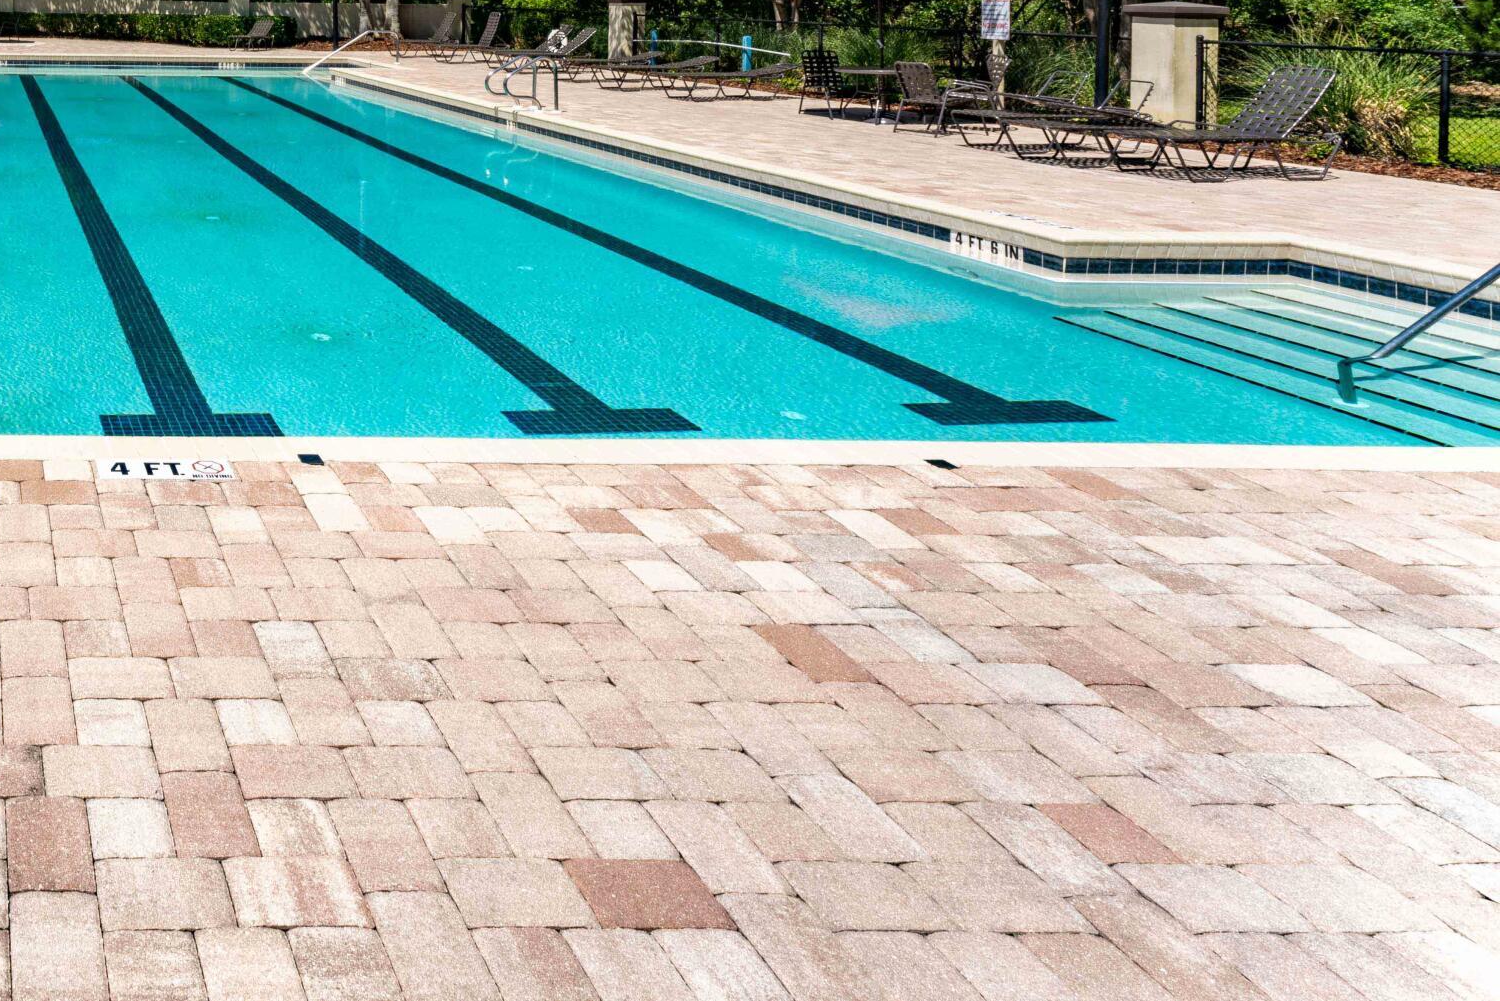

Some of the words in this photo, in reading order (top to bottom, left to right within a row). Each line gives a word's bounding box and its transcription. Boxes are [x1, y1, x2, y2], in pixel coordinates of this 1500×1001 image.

[955, 232, 963, 245] 4
[990, 241, 998, 254] 6
[110, 462, 130, 476] 4
